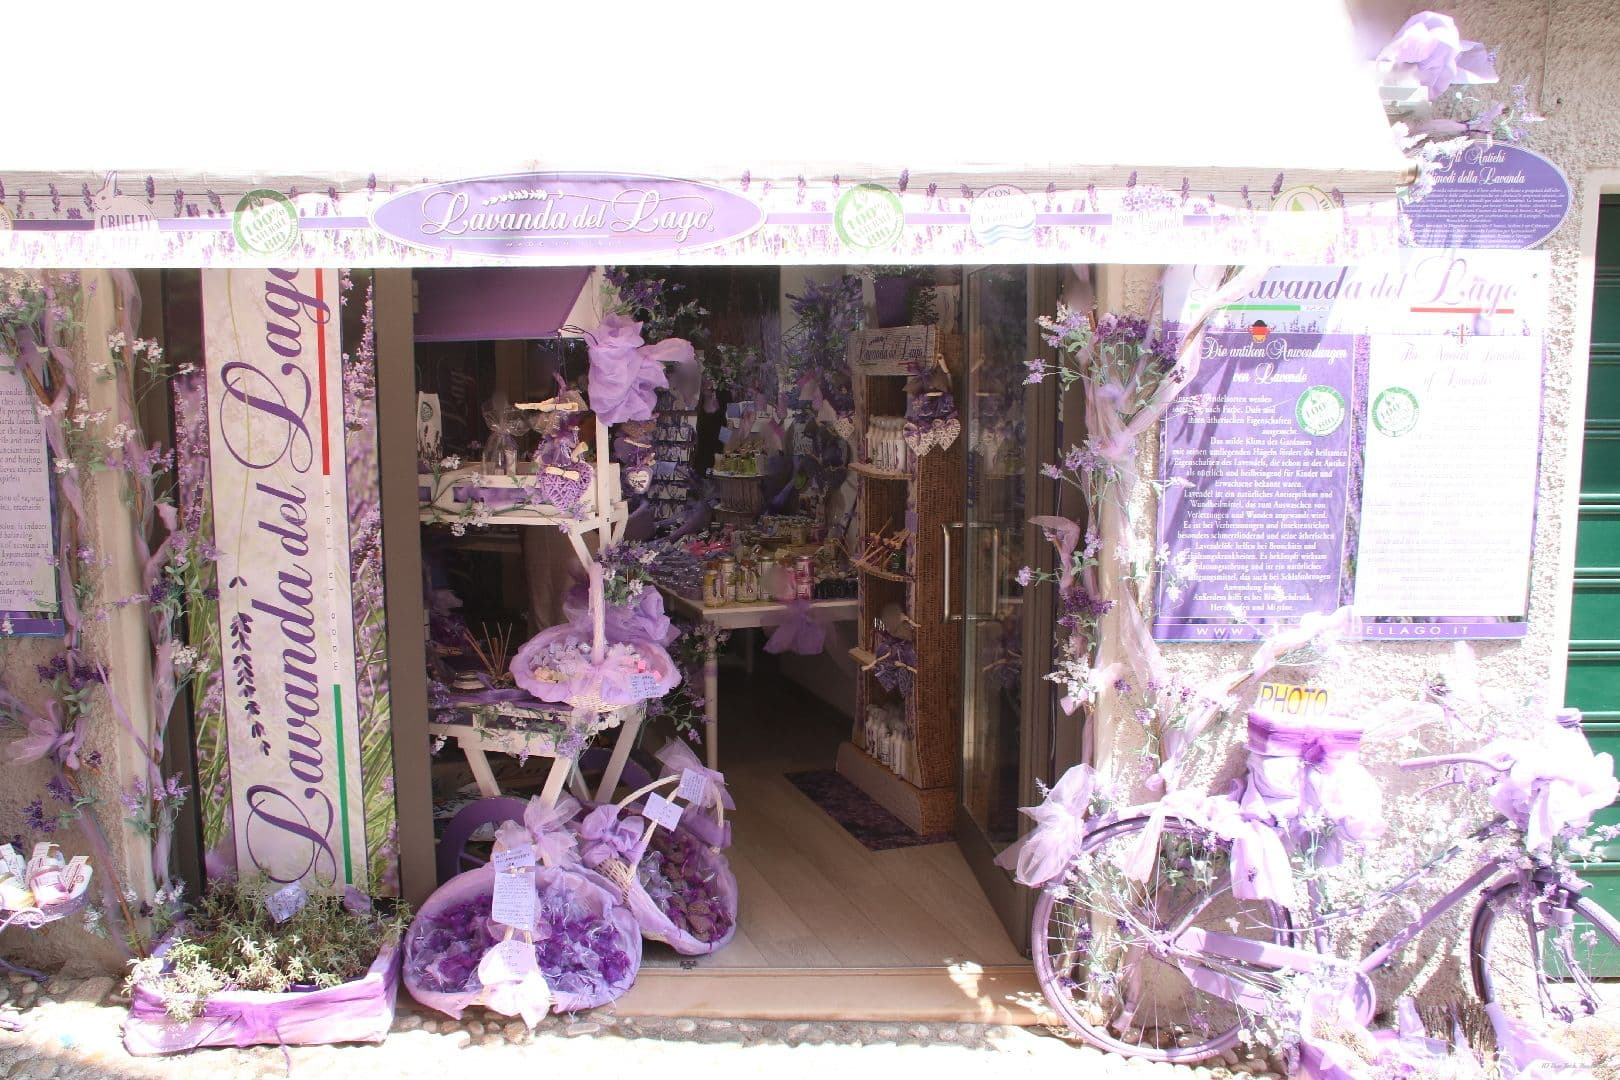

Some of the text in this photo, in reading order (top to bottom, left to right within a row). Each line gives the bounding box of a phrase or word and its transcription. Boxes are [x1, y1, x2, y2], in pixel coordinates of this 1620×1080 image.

[1465, 145, 1507, 166] Antichi
[1457, 169, 1477, 184] della
[1479, 166, 1526, 185] Lavanda
[987, 189, 1011, 198] CON
[420, 187, 714, 242] Lavanda del Lago
[100, 214, 152, 232] CRUELTY
[867, 226, 891, 245] BIO
[264, 232, 286, 250] BIO
[1369, 270, 1407, 299] del
[1414, 256, 1518, 315] Lago
[1200, 337, 1347, 365] Die antiken Anwendungen
[1247, 416, 1292, 426] Eigenschaften
[1210, 437, 1224, 446] Das
[1225, 437, 1245, 446] milde
[1246, 437, 1266, 446] Klima
[1267, 437, 1278, 446] des
[1209, 448, 1251, 458] umliegenden
[1253, 447, 1277, 458] Hügeln
[1279, 447, 1302, 456] fördert
[1303, 447, 1314, 456] die
[1315, 447, 1348, 456] heilsamen
[1174, 458, 1346, 468] Eigenschaften des Lavendels, die schon in der Antike
[1186, 468, 1196, 477] als
[1226, 469, 1239, 478] und
[1240, 469, 1282, 479] heilbringend
[1283, 468, 1294, 478] für
[1296, 469, 1318, 478] Kinder
[1319, 469, 1333, 478] und
[1215, 479, 1253, 488] Erwachsene
[1254, 479, 1280, 488] bekannt
[1184, 488, 1333, 500] Lavendel ist ein natürliches Antiseptikum und
[1189, 499, 1244, 509] Wundheilmittel,
[1245, 499, 1256, 508] das
[1273, 500, 1312, 509] Auswaschen
[255, 484, 308, 555] del
[1231, 510, 1244, 519] und
[1246, 510, 1273, 519] Wunden
[1183, 521, 1192, 529] Es
[1193, 521, 1201, 529] ist
[1202, 521, 1213, 529] bei
[1266, 521, 1279, 529] und
[1280, 521, 1330, 530] Insektenstichen
[1177, 530, 1210, 540] besonders
[1266, 531, 1279, 540] und
[1280, 532, 1297, 540] seine
[1298, 531, 1335, 540] ätherischen
[1257, 541, 1268, 550] bei
[1303, 542, 1317, 550] und
[1251, 562, 1264, 571] und
[1265, 562, 1274, 571] ist
[1275, 563, 1285, 571] ein
[1286, 562, 1322, 571] natürliches
[1239, 573, 1251, 581] das
[1252, 572, 1268, 581] auch
[1269, 572, 1280, 581] bei
[1193, 592, 1226, 601] Außerdem
[1251, 592, 1262, 600] bei
[1251, 603, 1264, 611] und
[1260, 684, 1328, 716] PHOTO
[246, 562, 337, 886] Lavanda
